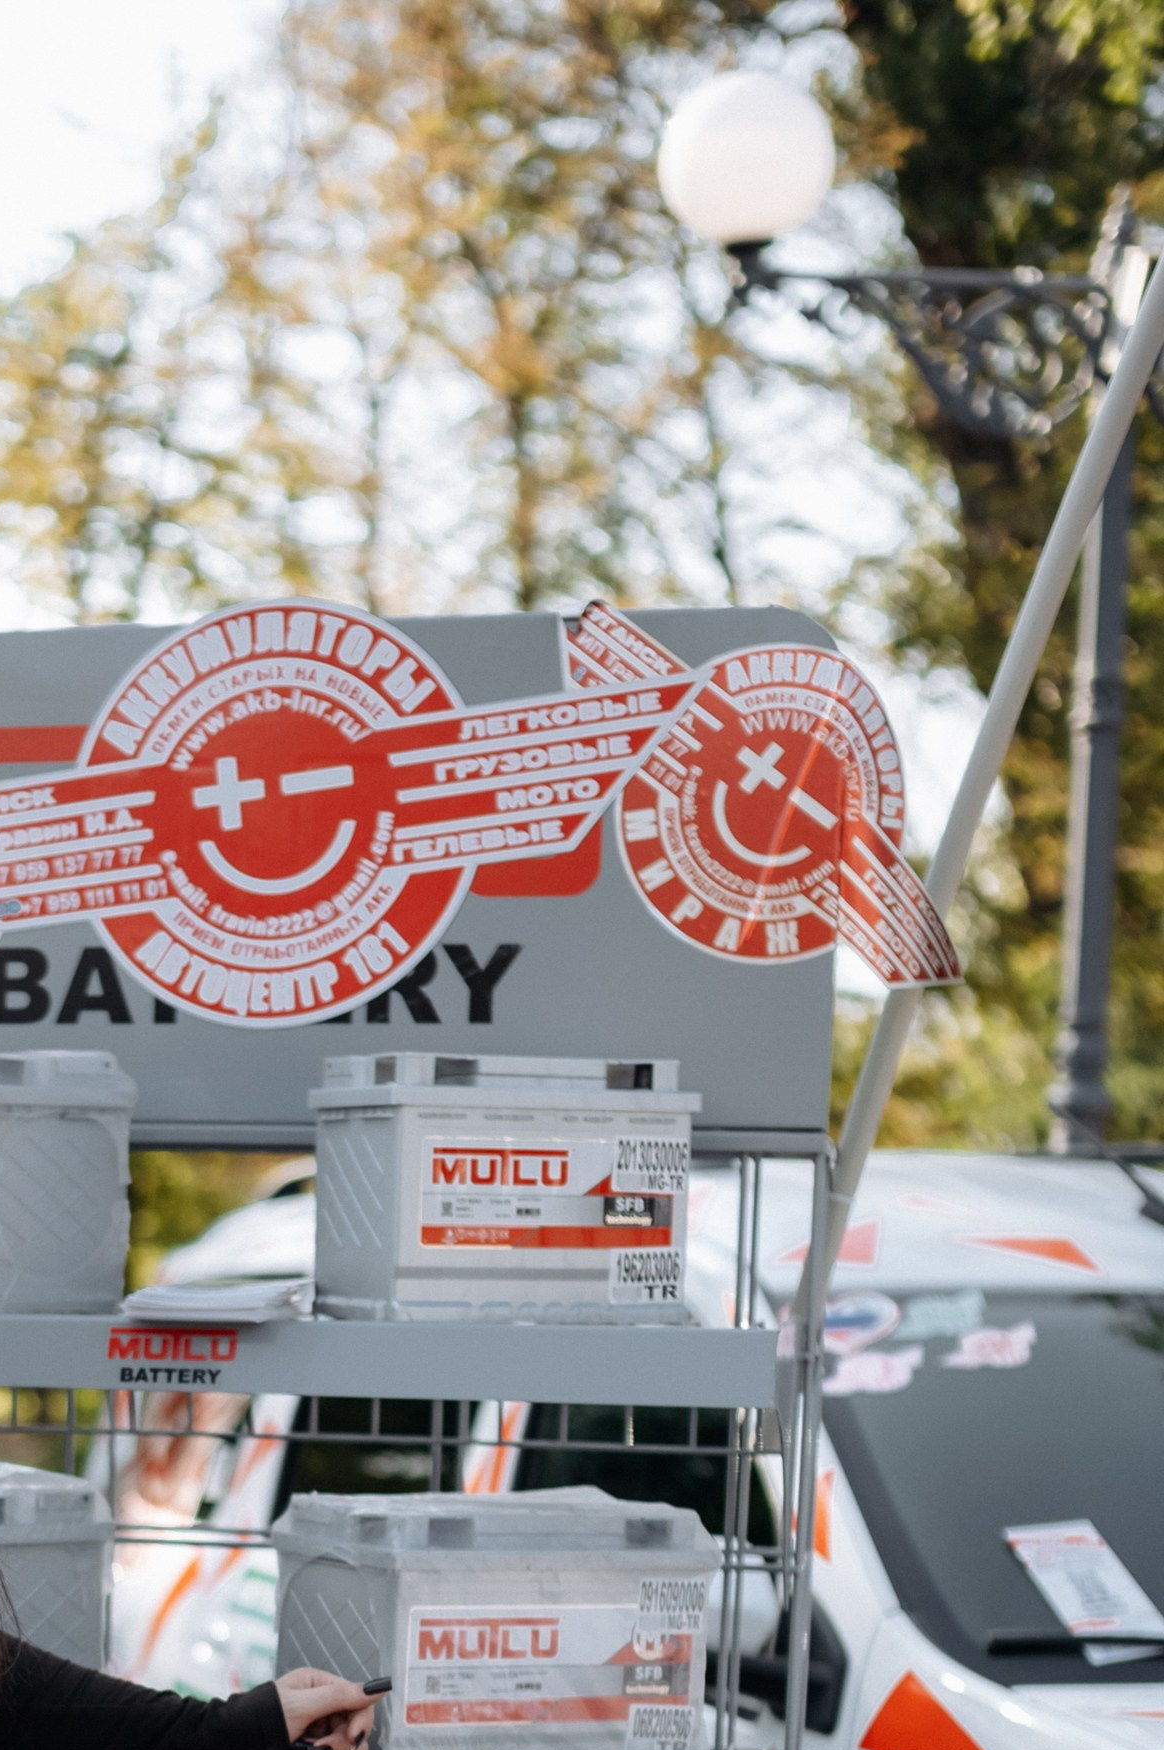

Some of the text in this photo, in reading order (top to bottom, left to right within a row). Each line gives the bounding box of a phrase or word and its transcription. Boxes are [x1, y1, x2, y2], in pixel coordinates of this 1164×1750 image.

[589, 606, 673, 677] УГАНСК
[101, 610, 437, 756] АККУМУЛЯТОРЫ
[294, 666, 318, 683] НА
[459, 690, 663, 742] ЛЕГКОВЫЕ
[436, 734, 633, 783] ГРУЗОВЫЕ
[497, 778, 601, 811] МОТО
[393, 820, 565, 863] ГЕЛЕВЫЕ
[134, 920, 410, 1017] АВТОЦЕНТР 181
[433, 1147, 569, 1187] MUTLU
[645, 1285, 679, 1300] TR
[107, 1327, 239, 1362] MUTLU
[120, 1367, 222, 1385] BATTERY
[418, 1618, 560, 1660] MUTLU
